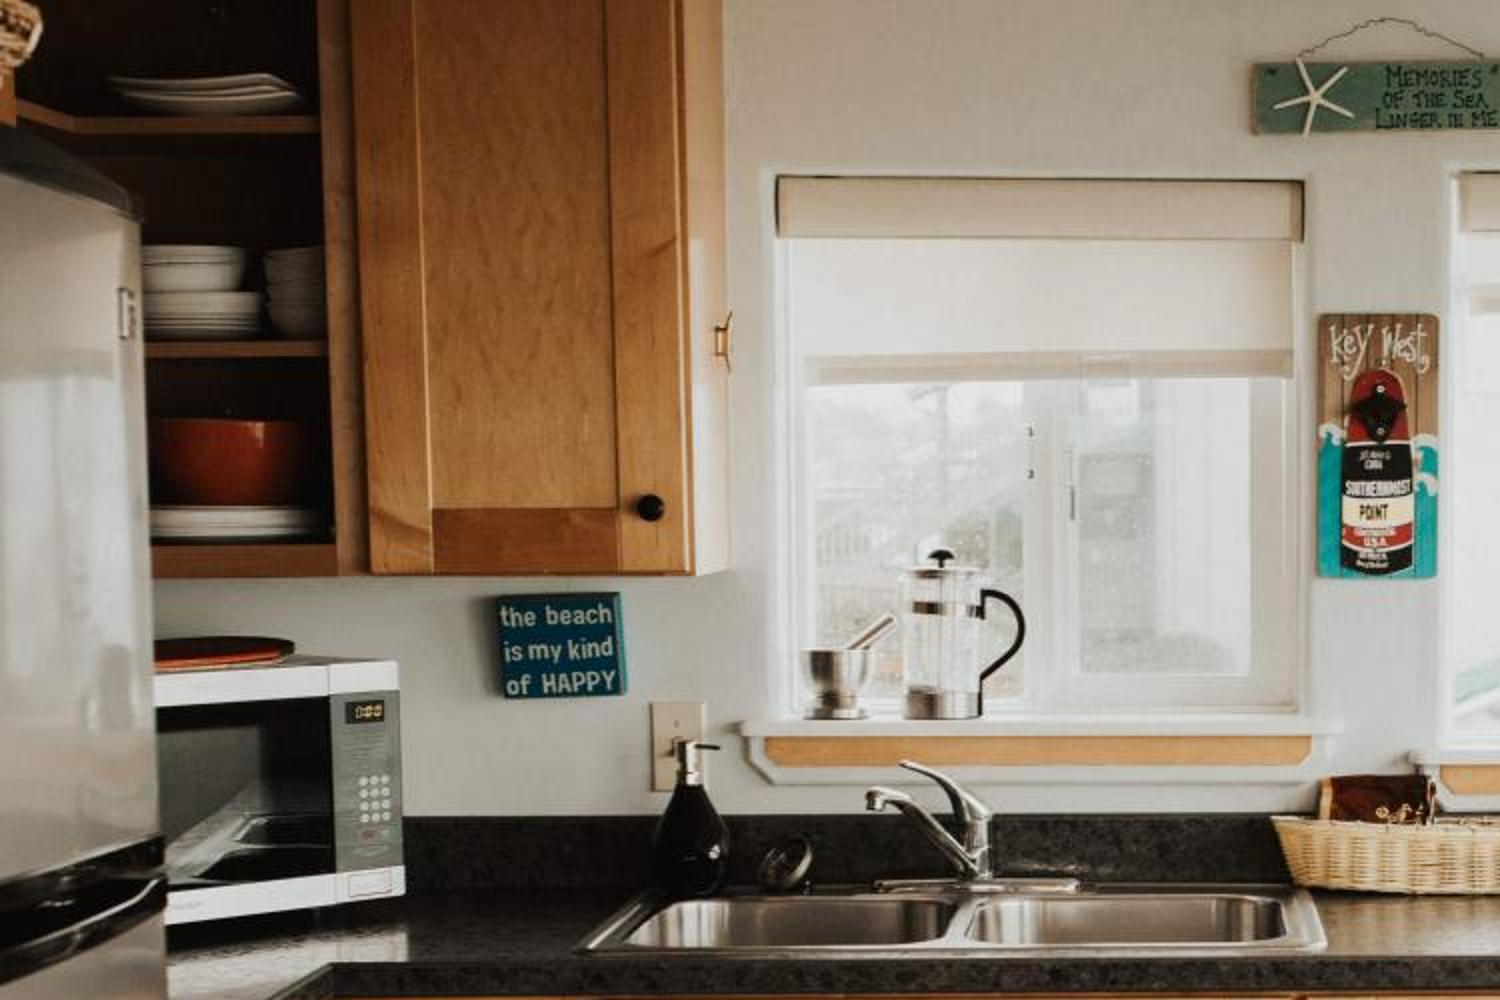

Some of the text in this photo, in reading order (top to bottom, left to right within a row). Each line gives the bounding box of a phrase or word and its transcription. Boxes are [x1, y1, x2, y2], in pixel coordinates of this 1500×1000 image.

[1383, 90, 1404, 109] OF
[1412, 90, 1447, 109] THE
[1381, 323, 1431, 374] West
[1359, 503, 1389, 521] POINT
[500, 602, 613, 628] the beach
[502, 636, 614, 665] is my kind
[505, 669, 617, 696] of HAPPY
